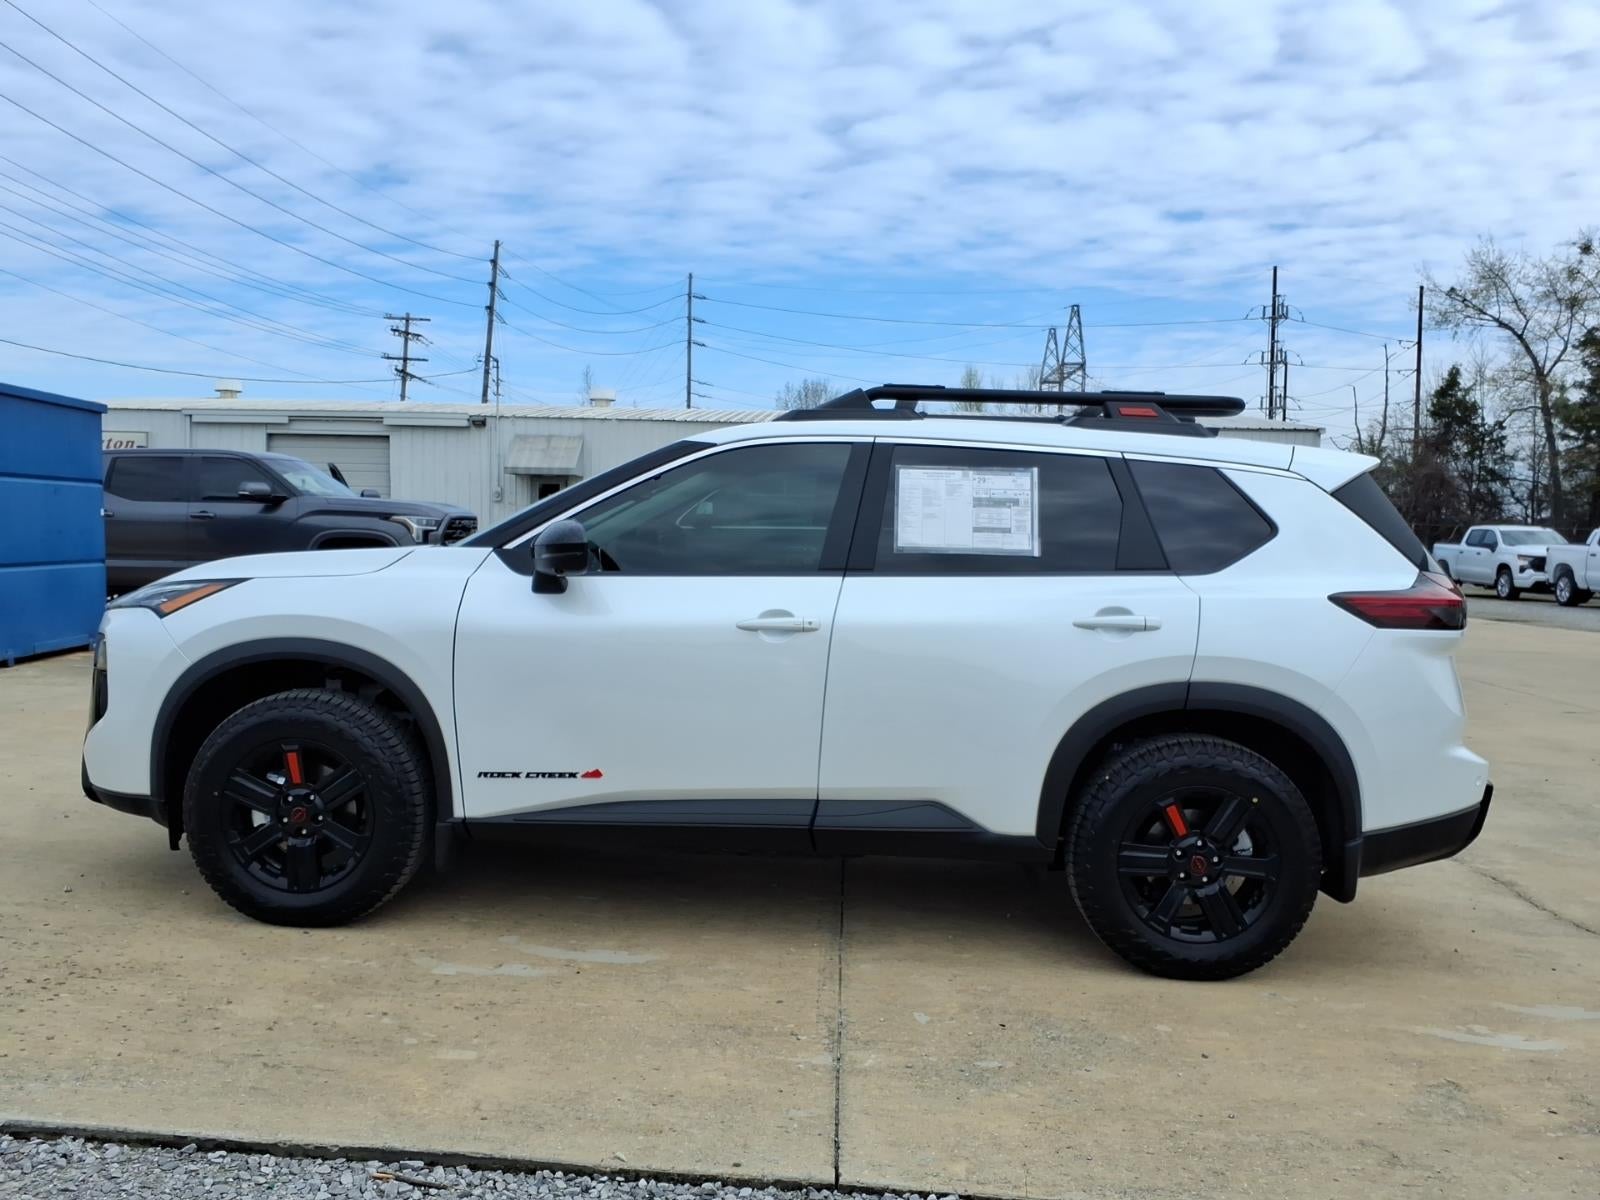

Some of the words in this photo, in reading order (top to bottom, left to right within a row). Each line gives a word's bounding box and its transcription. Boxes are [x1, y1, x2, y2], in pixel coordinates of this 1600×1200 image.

[102, 437, 135, 449] ton
[477, 771, 523, 779] ROCK
[525, 771, 579, 779] CREEK
